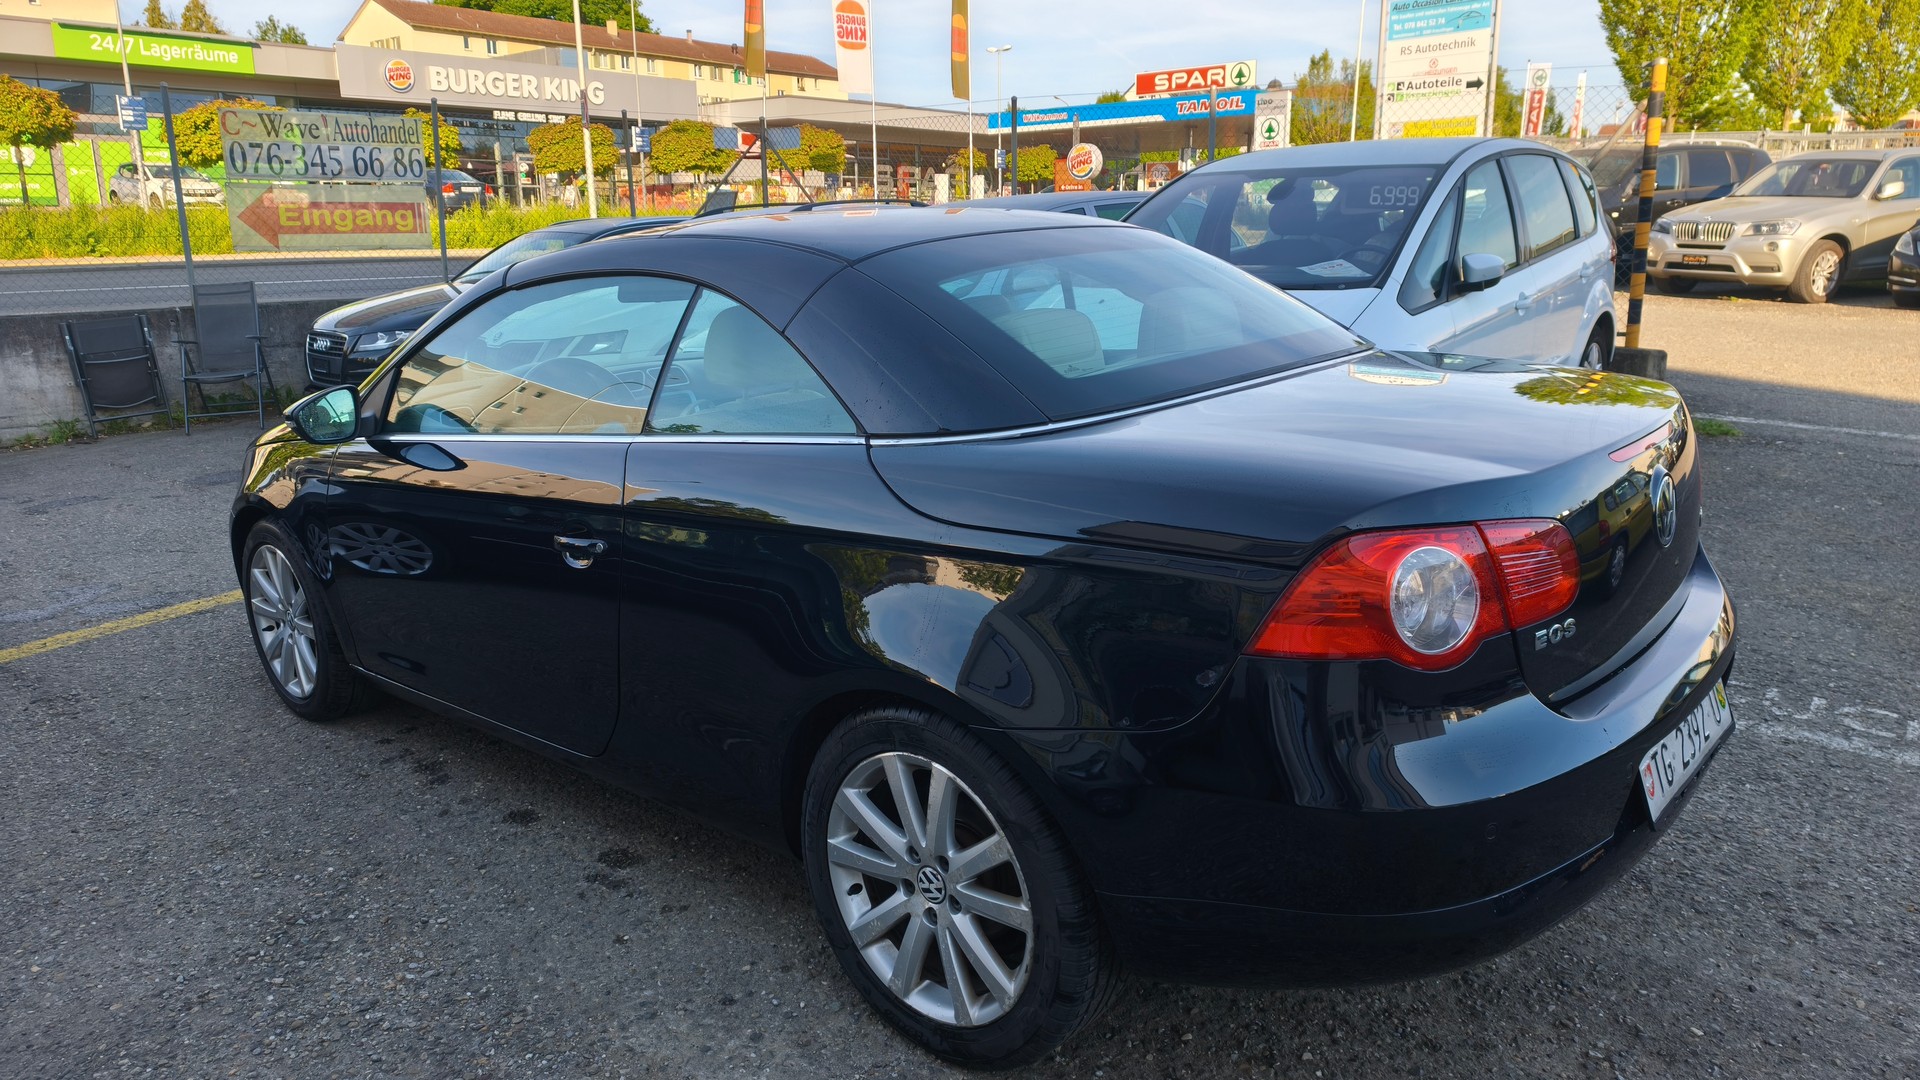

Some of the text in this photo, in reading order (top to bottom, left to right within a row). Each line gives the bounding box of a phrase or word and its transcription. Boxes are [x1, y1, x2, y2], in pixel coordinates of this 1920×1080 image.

[1392, 1, 1411, 11] Auto
[139, 39, 239, 64] Lagerräume
[1400, 37, 1477, 56] RS Autotechnik
[388, 71, 412, 82] KING
[429, 65, 606, 106] BURGER KING
[1154, 67, 1225, 91] SPAR
[1406, 76, 1463, 91] Autoteile
[1177, 96, 1246, 115] TAMOIL
[333, 116, 422, 145] Autohandel
[228, 140, 424, 178] 076-345 66 86
[1070, 156, 1094, 172] KING
[1369, 185, 1420, 206] 6.999
[277, 203, 415, 233] Eingang
[1535, 617, 1577, 651] EOS
[1650, 741, 1675, 798] TG
[1675, 702, 1711, 771] 2392
